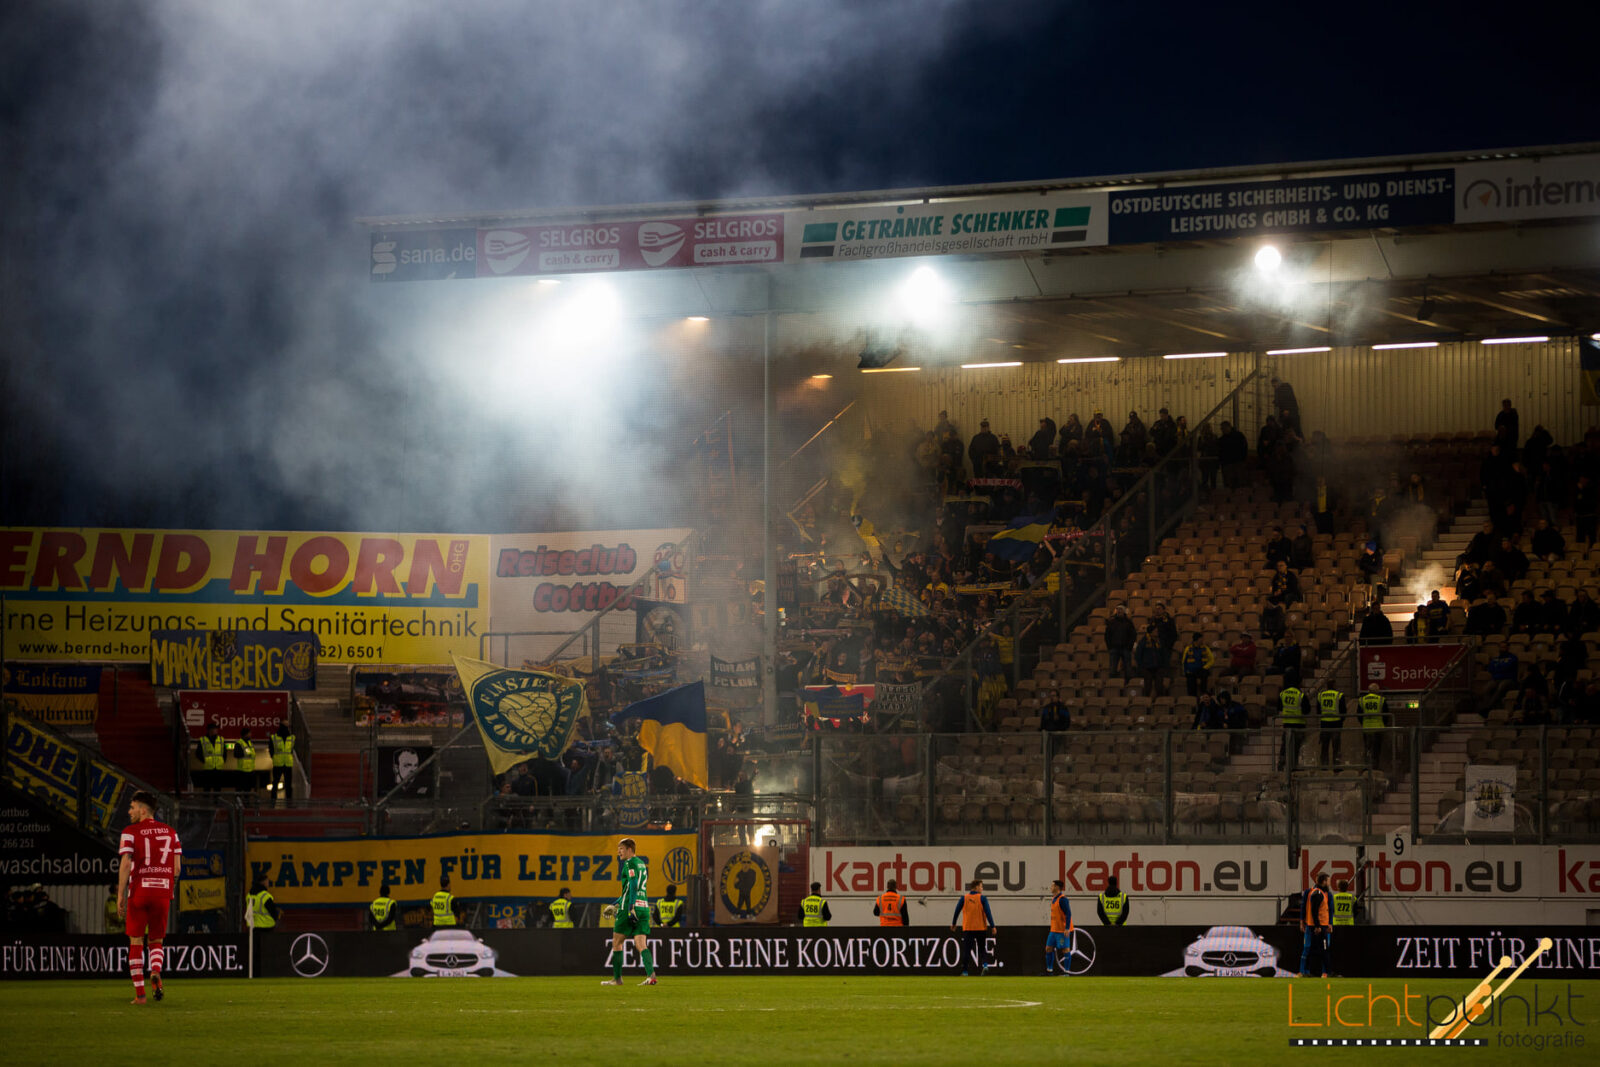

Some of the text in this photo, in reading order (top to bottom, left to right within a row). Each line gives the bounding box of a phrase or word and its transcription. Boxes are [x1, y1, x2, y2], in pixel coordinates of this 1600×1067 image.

[1112, 177, 1452, 215] OSTDEUTSCHE SICHERHEITS- UND DIENST-
[1506, 176, 1600, 208] intern
[694, 219, 777, 240] SELGROS
[951, 209, 1050, 235] SCHENKER
[1171, 204, 1390, 233] LEISTUNGS GMBH & CO. KG
[540, 227, 620, 248] SELGROS
[838, 232, 1048, 258] Fachgroßhandelsgesellschaft mbH
[401, 240, 475, 265] sana.de
[545, 253, 614, 266] cash & carry
[700, 244, 771, 259] cash & carry
[228, 535, 470, 595] HORN
[450, 543, 464, 573] OHG
[497, 543, 637, 577] Reiseclub
[0, 605, 477, 637] rne Heizungs- und Sanitärtechnik
[347, 646, 383, 659] 6501
[16, 668, 88, 689] Lokfans
[1392, 665, 1463, 684] Sparkase
[211, 713, 281, 729] Sparkasse
[17, 822, 51, 833] Cottbus
[19, 838, 35, 849] 251
[144, 836, 173, 866] 17
[1393, 836, 1404, 856] 9
[251, 854, 426, 888] KÄMPFEN
[440, 847, 502, 881] FÜR
[637, 869, 648, 890] 12
[825, 850, 1026, 892] karton.eu
[1058, 850, 1268, 892] karton.eu
[805, 904, 819, 914] 268
[887, 903, 892, 911] 4
[1105, 900, 1120, 910] 256
[1337, 902, 1351, 912] 272
[3, 940, 244, 972] FÜR EINE KOMFTZONE.
[669, 932, 724, 968] FÜR
[728, 938, 789, 968] EINE
[1396, 937, 1461, 969] ZEIT
[1468, 931, 1529, 969] FÜR
